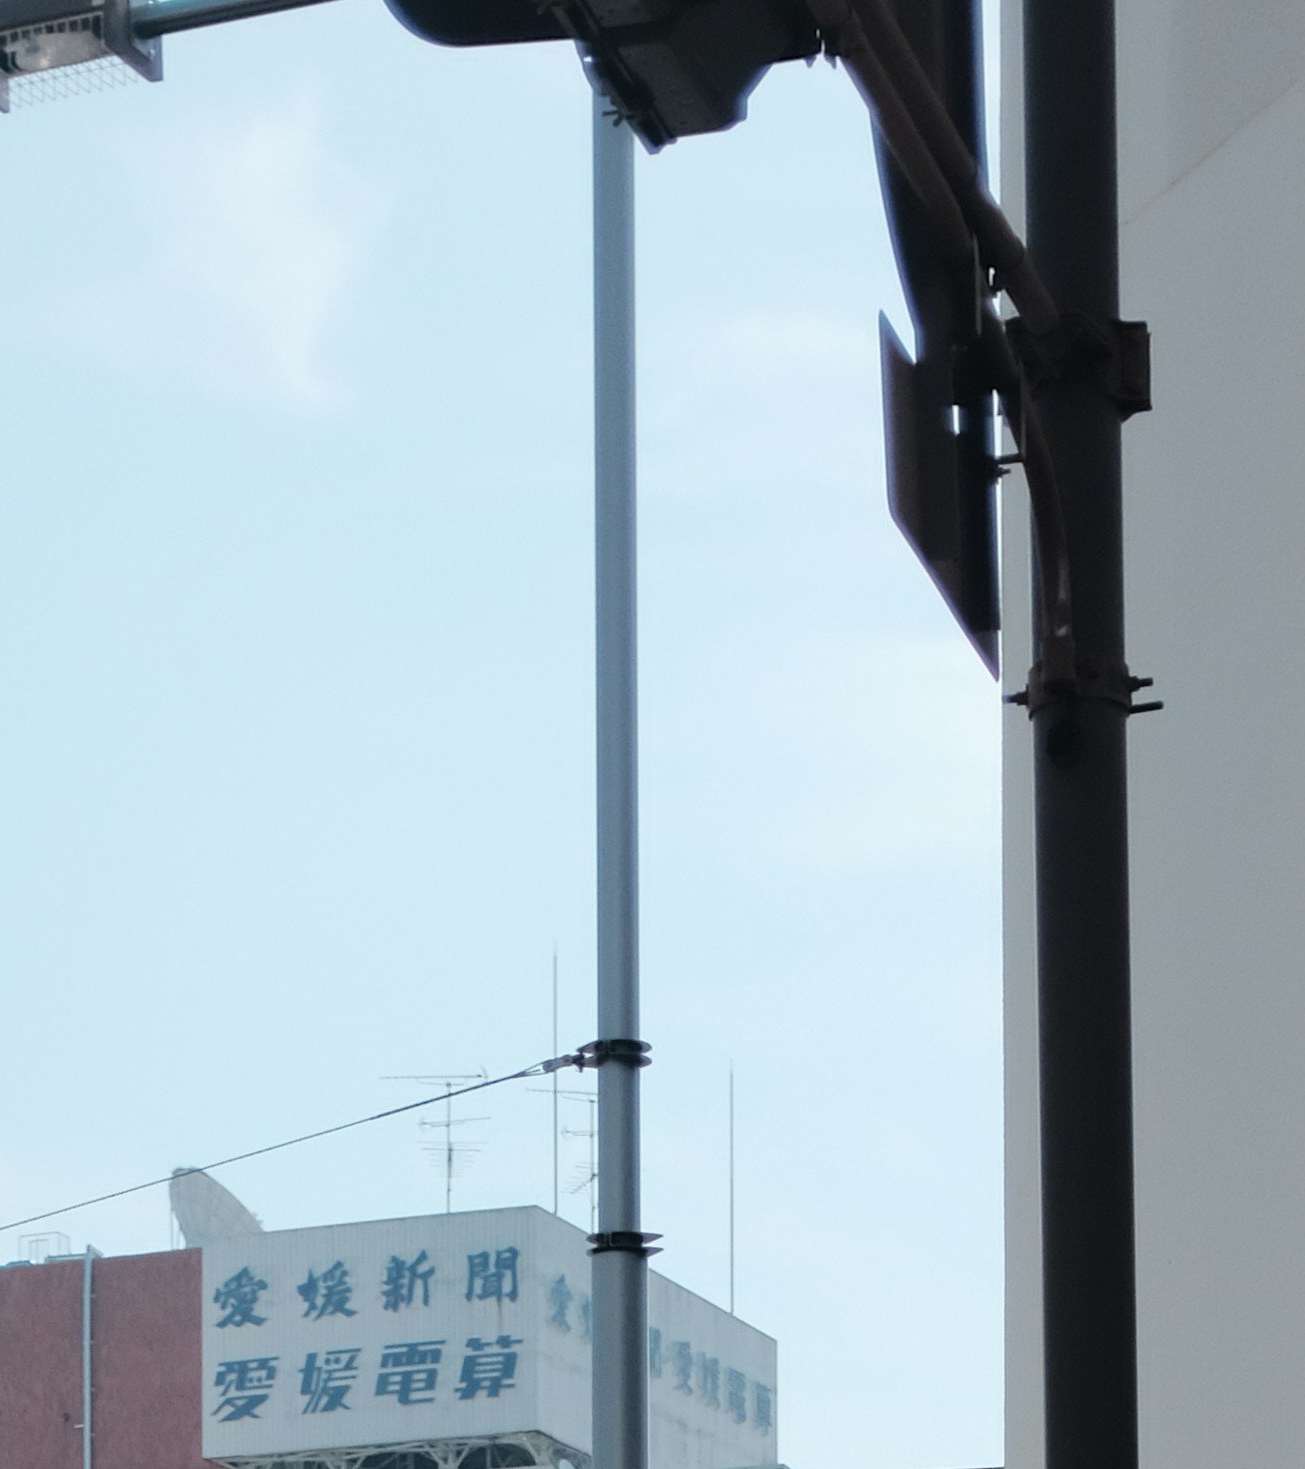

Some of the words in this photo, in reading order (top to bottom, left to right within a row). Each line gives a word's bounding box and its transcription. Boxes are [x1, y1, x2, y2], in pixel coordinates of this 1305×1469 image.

[213, 1245, 521, 1329] 愛媛新聞
[210, 1334, 523, 1422] 愛媛電算
